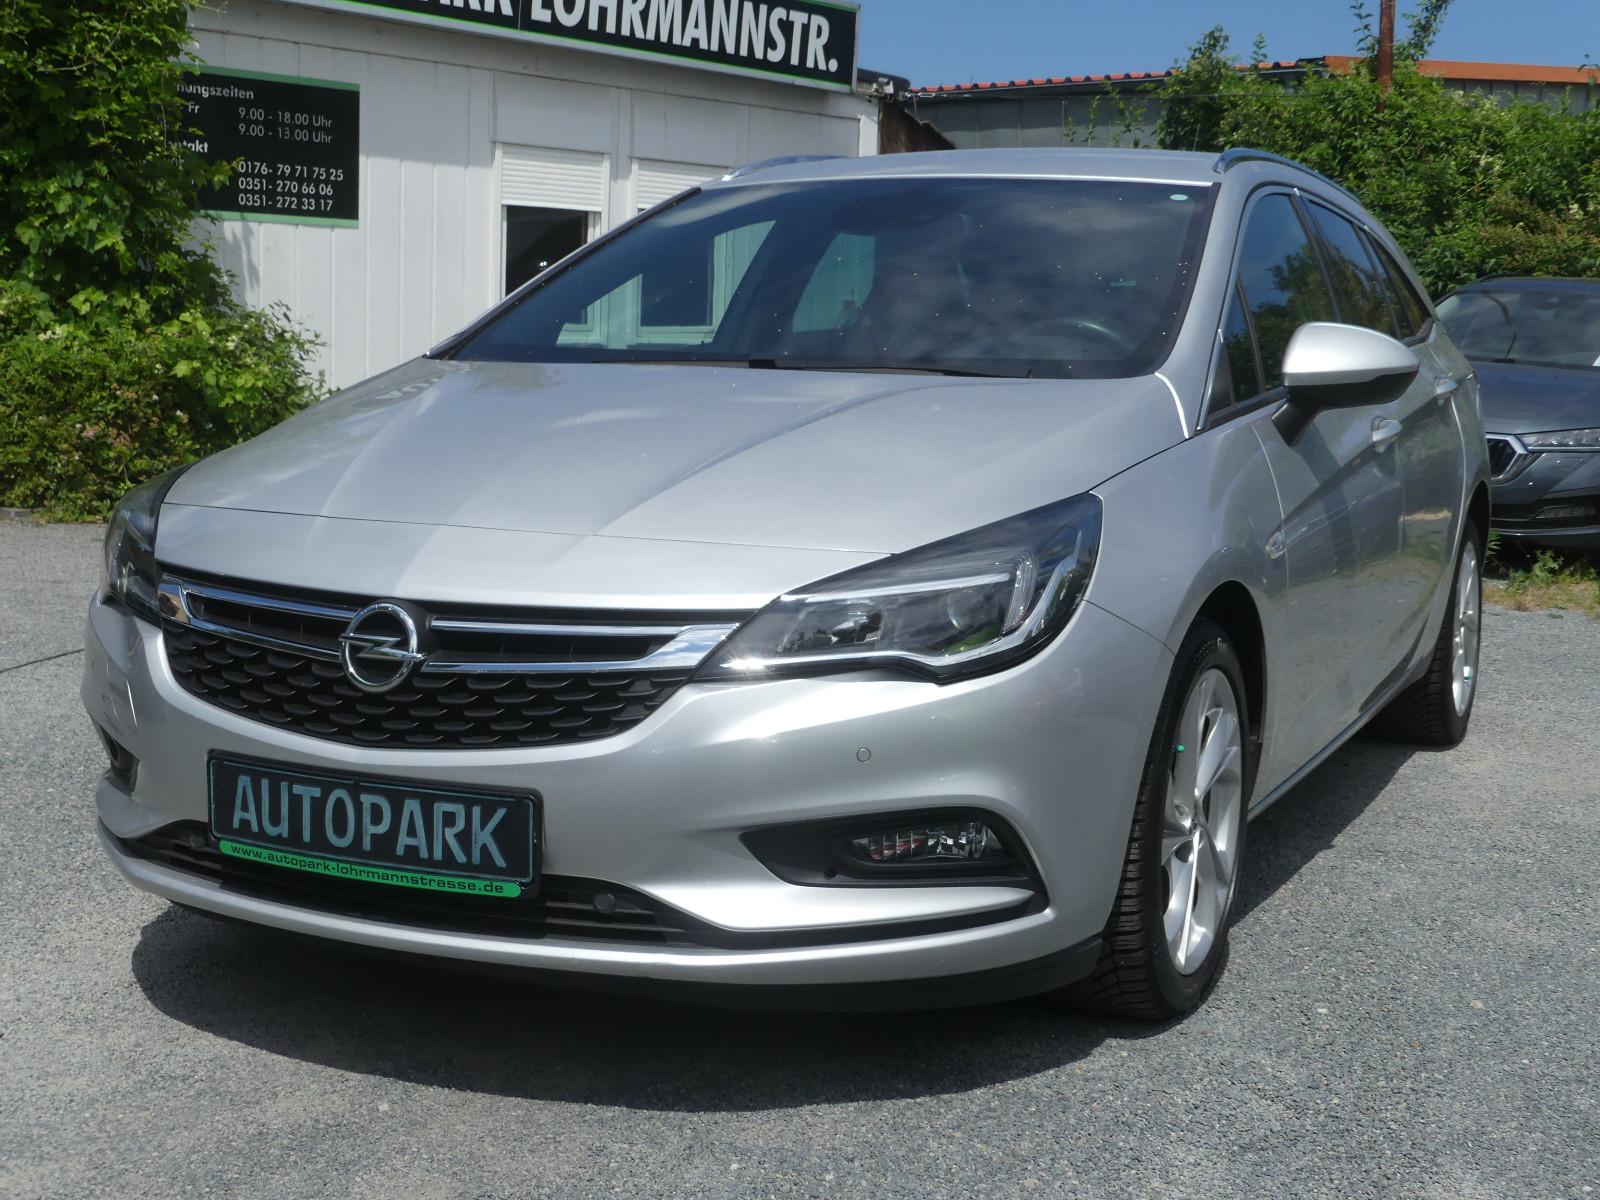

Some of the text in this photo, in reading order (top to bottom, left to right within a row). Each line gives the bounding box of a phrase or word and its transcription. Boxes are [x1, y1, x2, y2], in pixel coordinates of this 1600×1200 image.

[177, 84, 255, 99] nungszeiten
[239, 107, 264, 120] 9.00
[278, 111, 309, 126] 18.00
[313, 115, 332, 127] Uhr
[239, 123, 264, 136] 9.00
[278, 127, 309, 141] 13.00
[313, 131, 332, 143] Uhr
[277, 164, 291, 176] 79
[295, 165, 307, 178] 71
[313, 167, 326, 180] 75
[330, 168, 344, 181] 25
[276, 180, 298, 193] 270
[302, 182, 316, 195] 66
[319, 183, 333, 196] 06
[276, 196, 298, 209] 272
[302, 198, 316, 210] 33
[320, 199, 333, 211] 17
[232, 775, 508, 868] AUTOPARK
[231, 844, 504, 893] www.autopark-lohrmannstrasse.de
